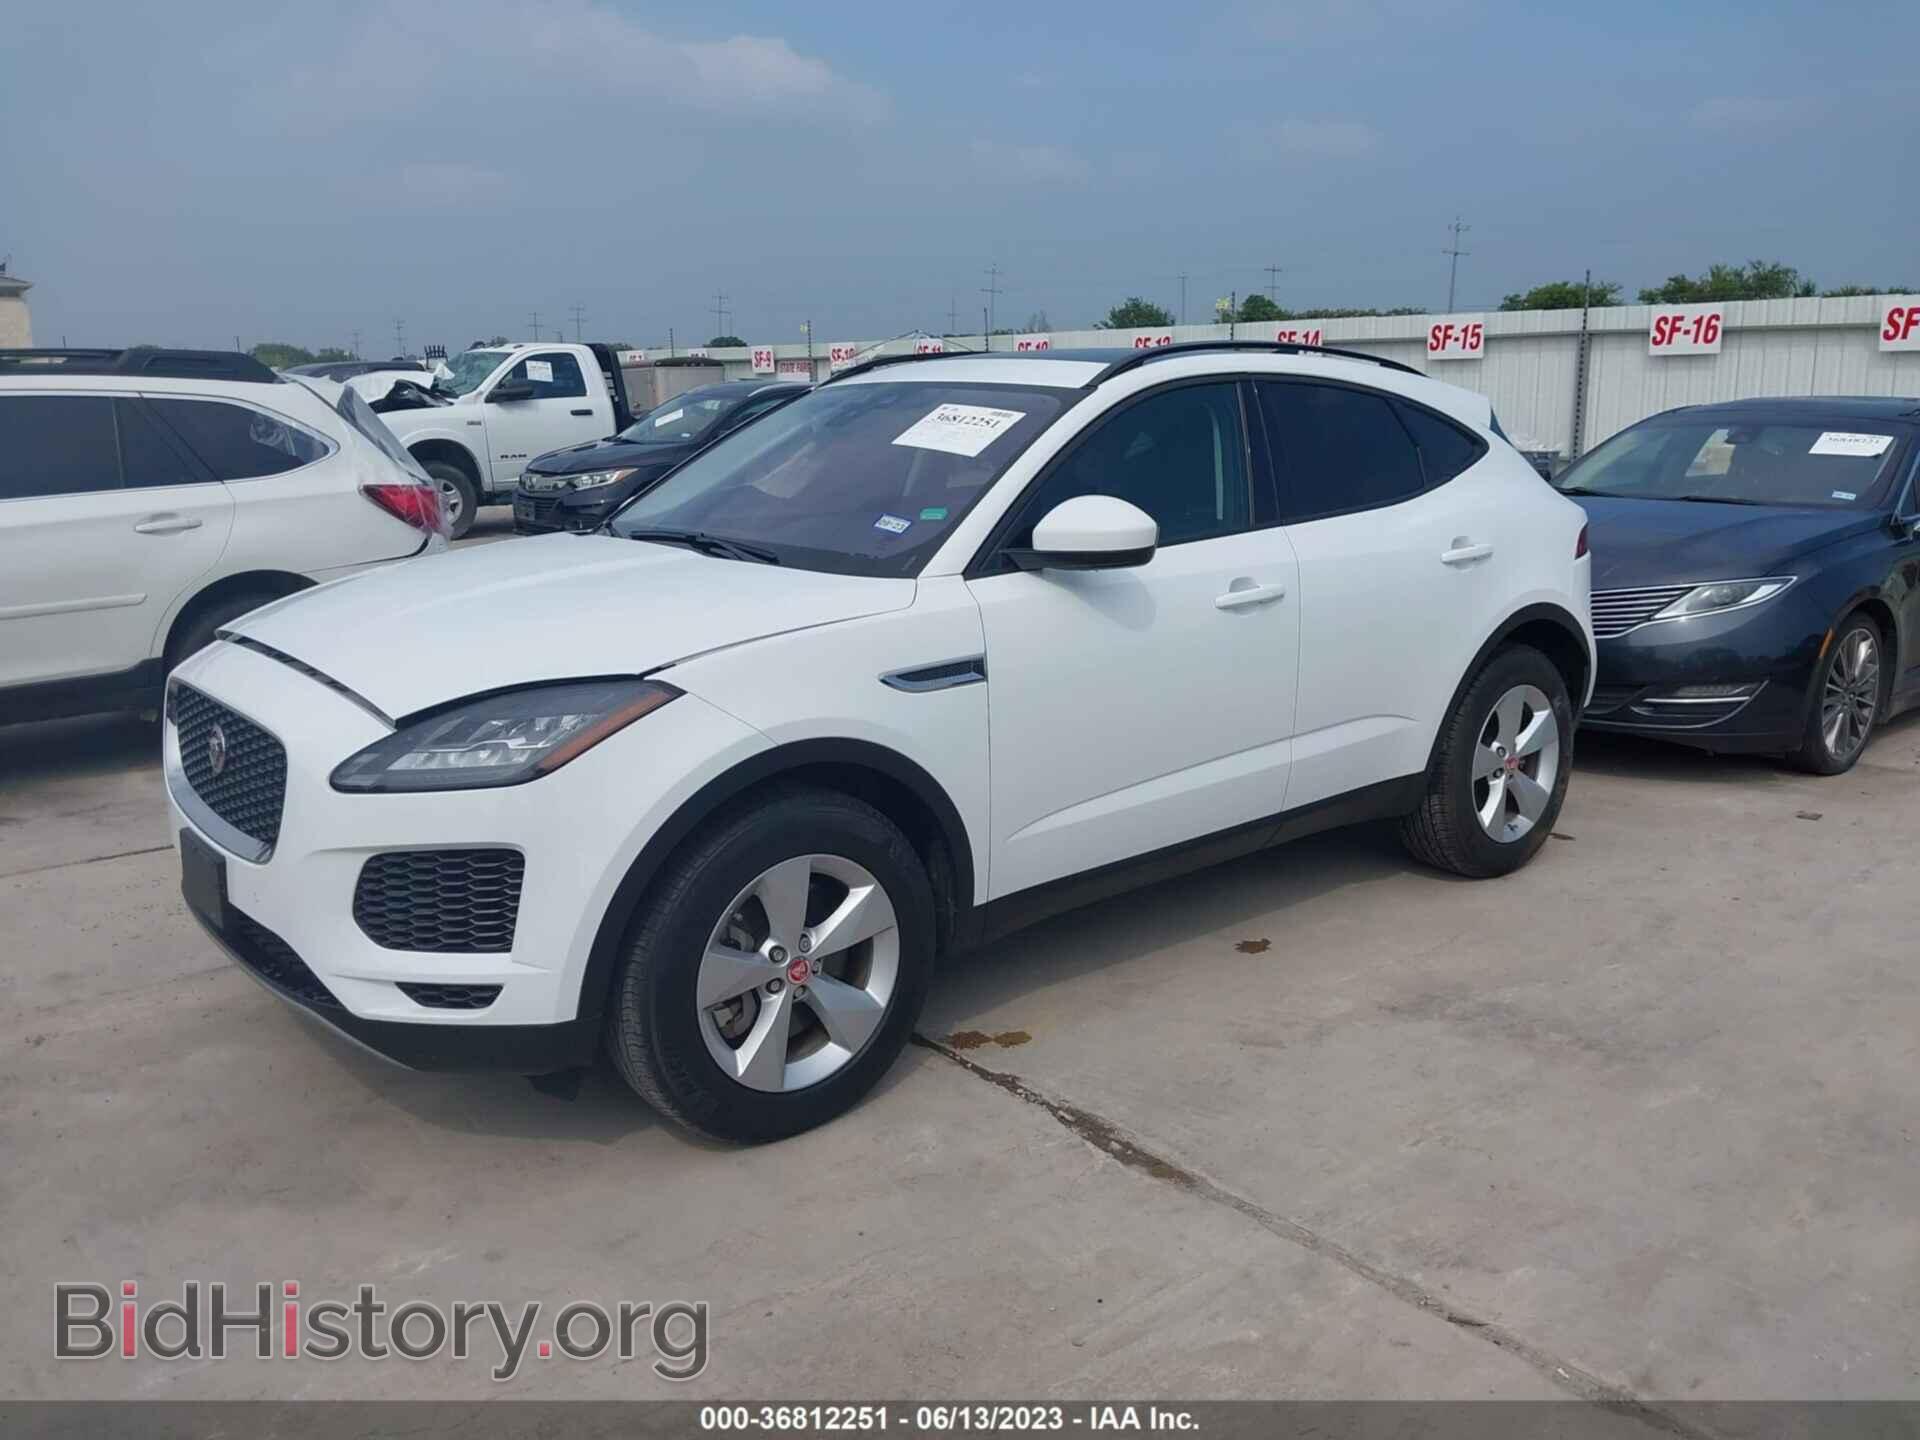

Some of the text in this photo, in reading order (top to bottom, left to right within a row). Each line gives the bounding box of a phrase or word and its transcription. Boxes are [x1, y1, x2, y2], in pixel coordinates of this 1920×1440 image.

[1429, 324, 1483, 351] SF-15
[1651, 314, 1721, 346] SF-16
[753, 350, 771, 369] SF-9
